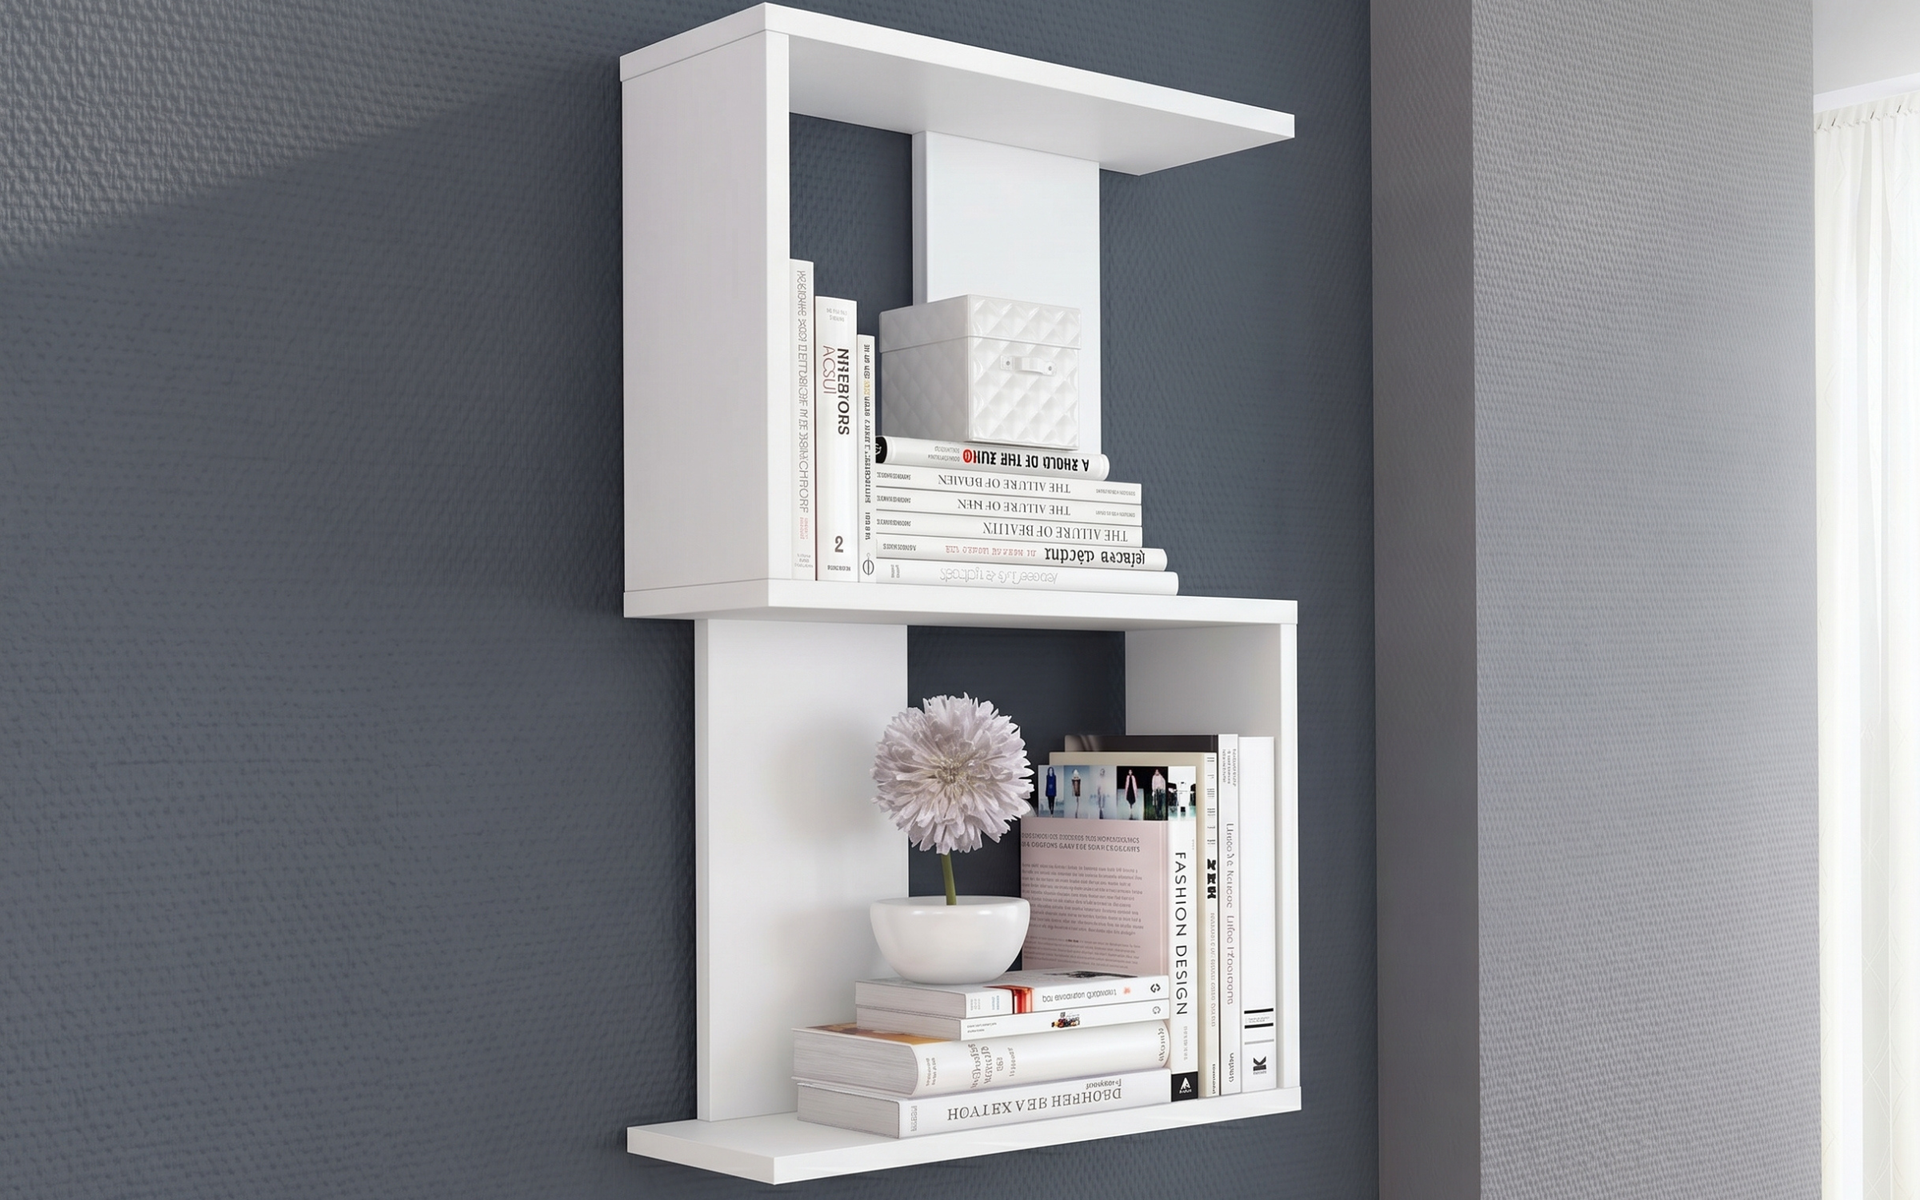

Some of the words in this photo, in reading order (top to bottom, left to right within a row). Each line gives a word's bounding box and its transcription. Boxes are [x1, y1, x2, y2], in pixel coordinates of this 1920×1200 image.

[985, 478, 1000, 489] OF
[1003, 479, 1046, 493] ALLURE
[1049, 483, 1071, 494] THE
[985, 501, 1000, 511] OF
[1003, 502, 1046, 514] ALLURE
[1049, 505, 1071, 516] THE
[1036, 525, 1053, 538] OF
[1056, 526, 1101, 540] ALLURE
[1104, 529, 1128, 542] THE
[834, 535, 844, 553] 2
[1175, 852, 1187, 936] FASHION
[1175, 945, 1188, 1015] DESIGN
